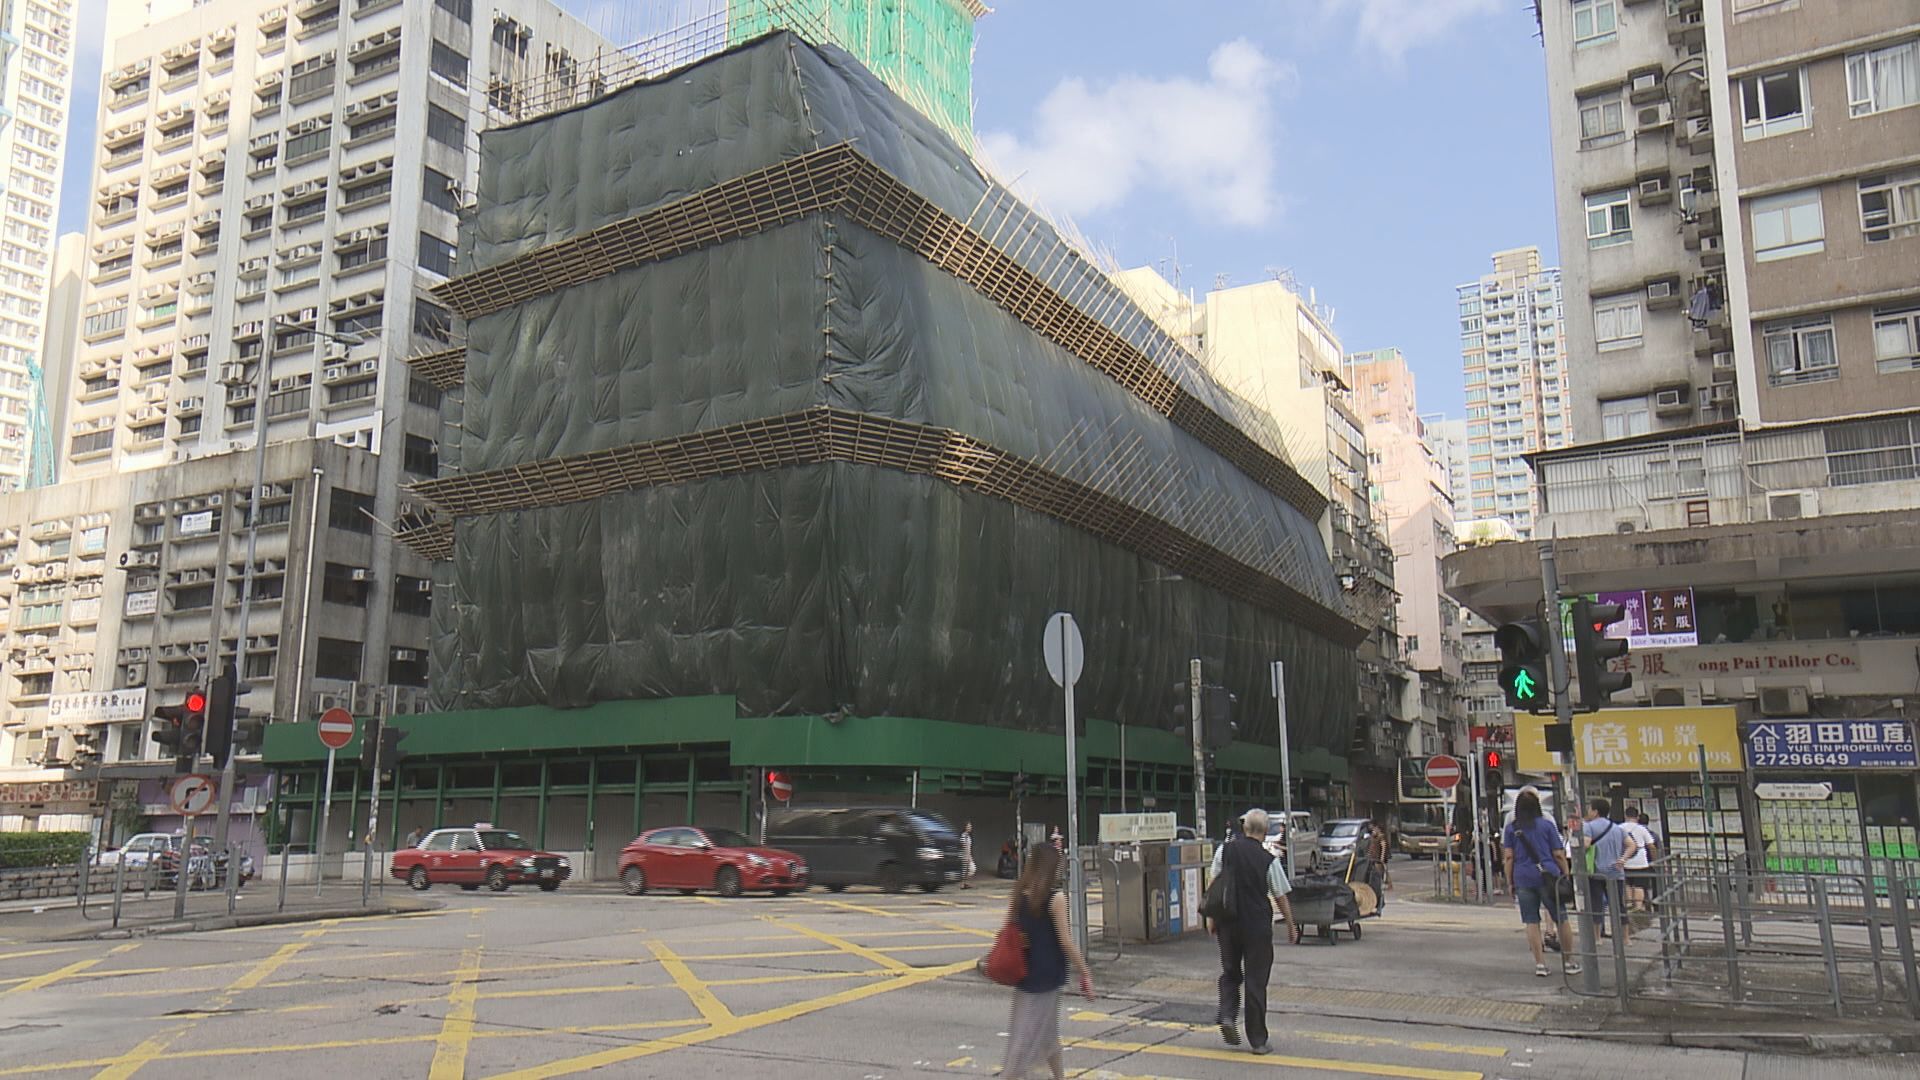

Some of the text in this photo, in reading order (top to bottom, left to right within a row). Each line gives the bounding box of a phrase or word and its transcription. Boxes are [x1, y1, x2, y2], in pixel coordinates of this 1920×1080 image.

[1733, 655, 1760, 670] Pai
[1764, 654, 1820, 669] Tailor
[1825, 653, 1856, 667] Co.
[1638, 724, 1698, 747] 物業
[1787, 744, 1810, 753] YUE
[1812, 744, 1832, 752] TIN
[1895, 743, 1913, 752] CO
[1641, 751, 1682, 766] 3689
[1755, 753, 1849, 766] 27296649
